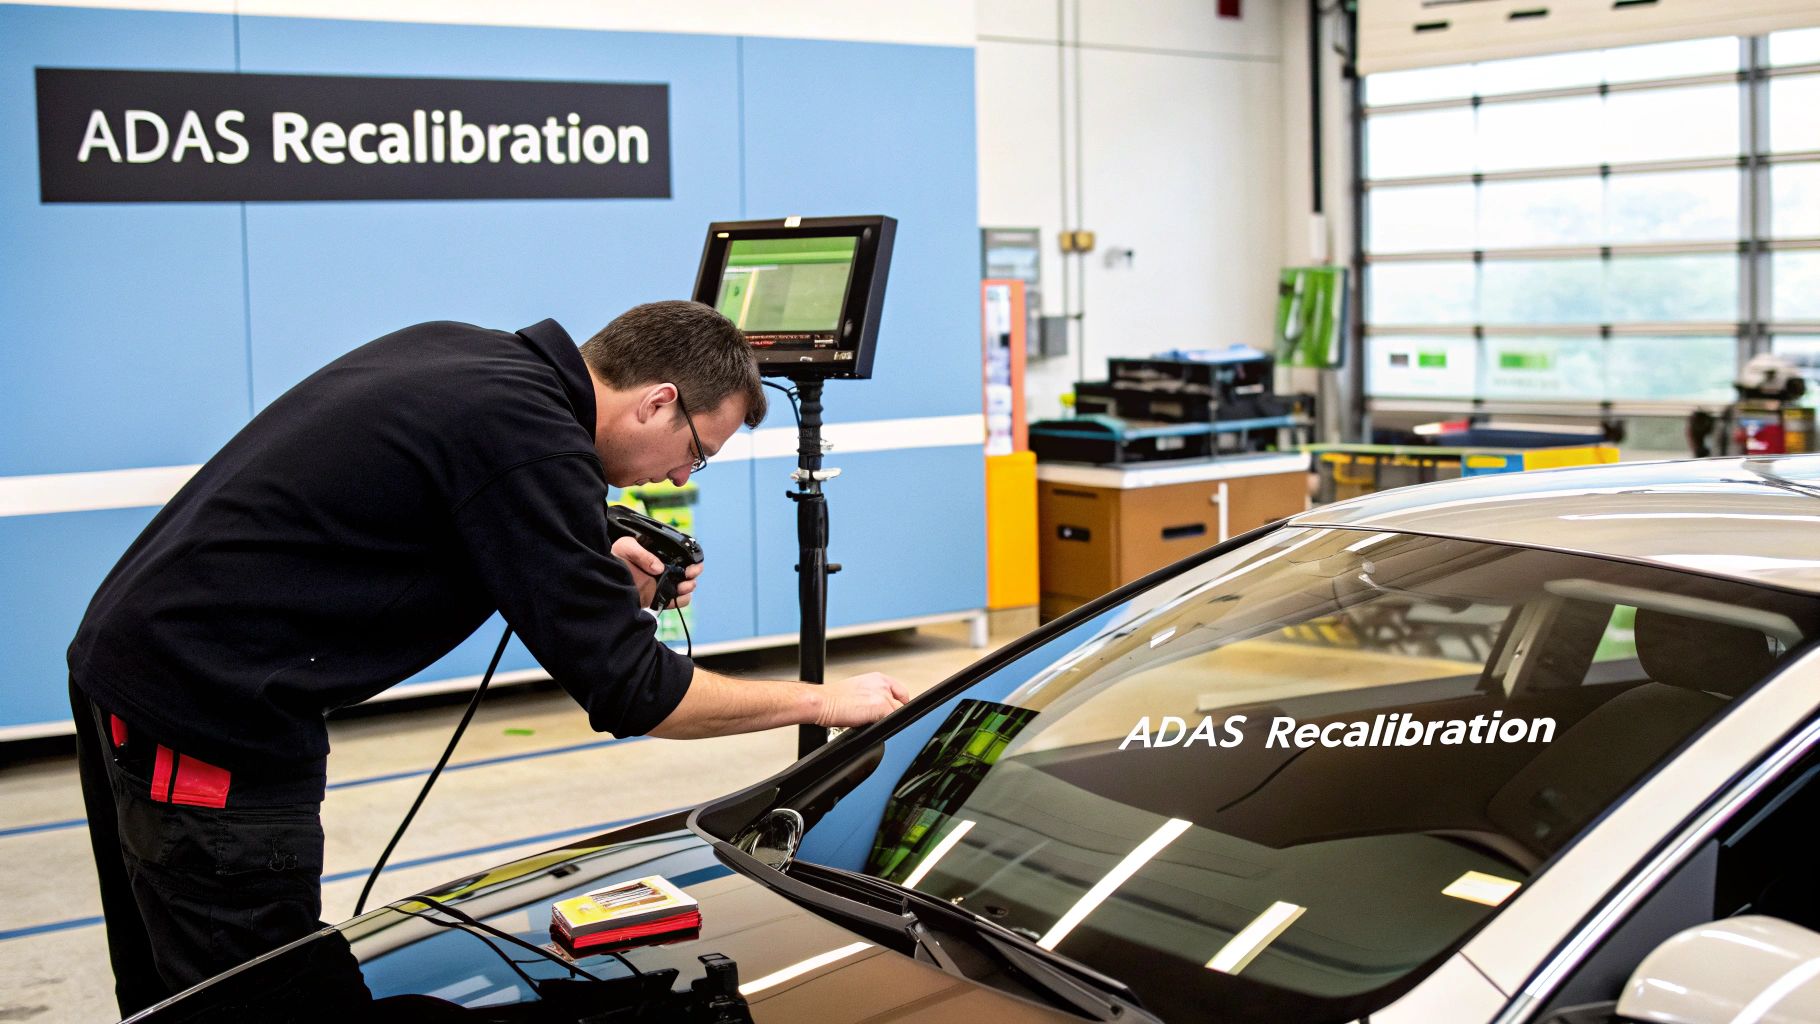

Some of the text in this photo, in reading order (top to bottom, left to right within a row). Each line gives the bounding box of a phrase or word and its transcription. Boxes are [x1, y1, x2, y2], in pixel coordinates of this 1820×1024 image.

[78, 110, 649, 164] ADAS Recalibration
[1118, 710, 1556, 751] ADAS Recalibration
